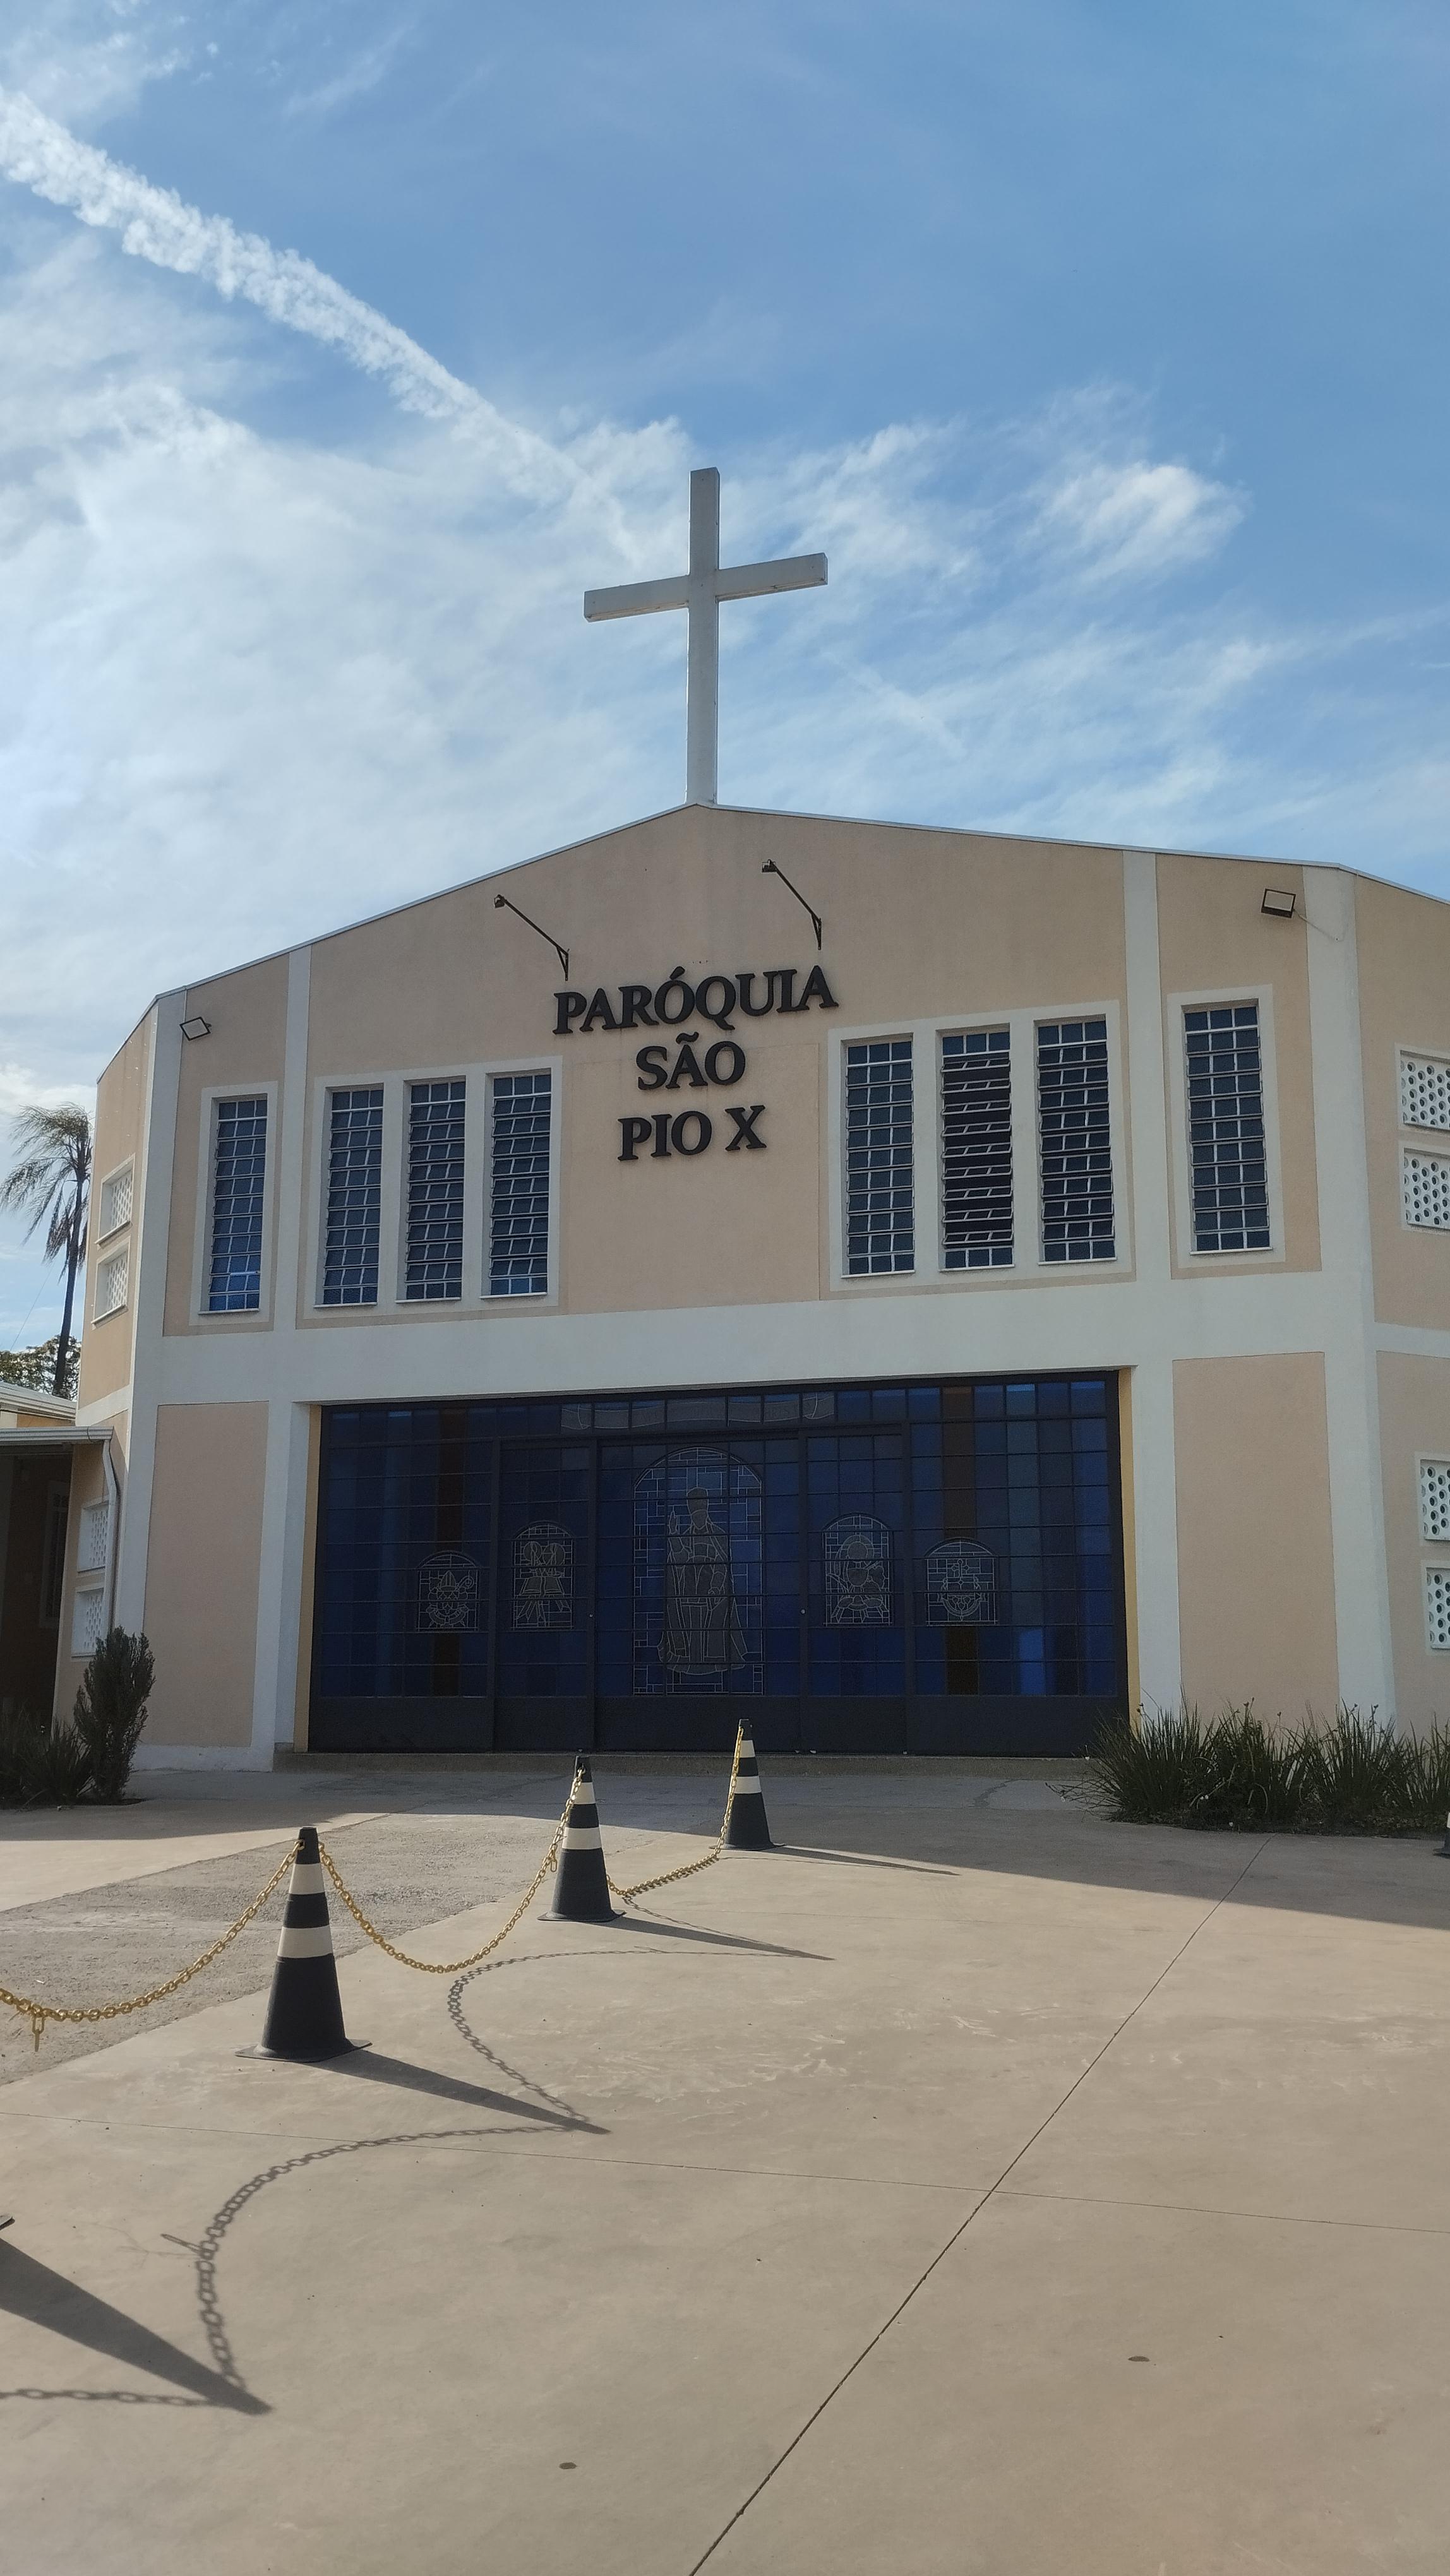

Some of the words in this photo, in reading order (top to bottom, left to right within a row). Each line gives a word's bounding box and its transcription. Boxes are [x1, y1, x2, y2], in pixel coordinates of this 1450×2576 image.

[553, 965, 839, 1035] PARÓQUIA
[636, 1032, 746, 1090] SÃO
[617, 1110, 712, 1161] PIO
[724, 1105, 767, 1151] X
